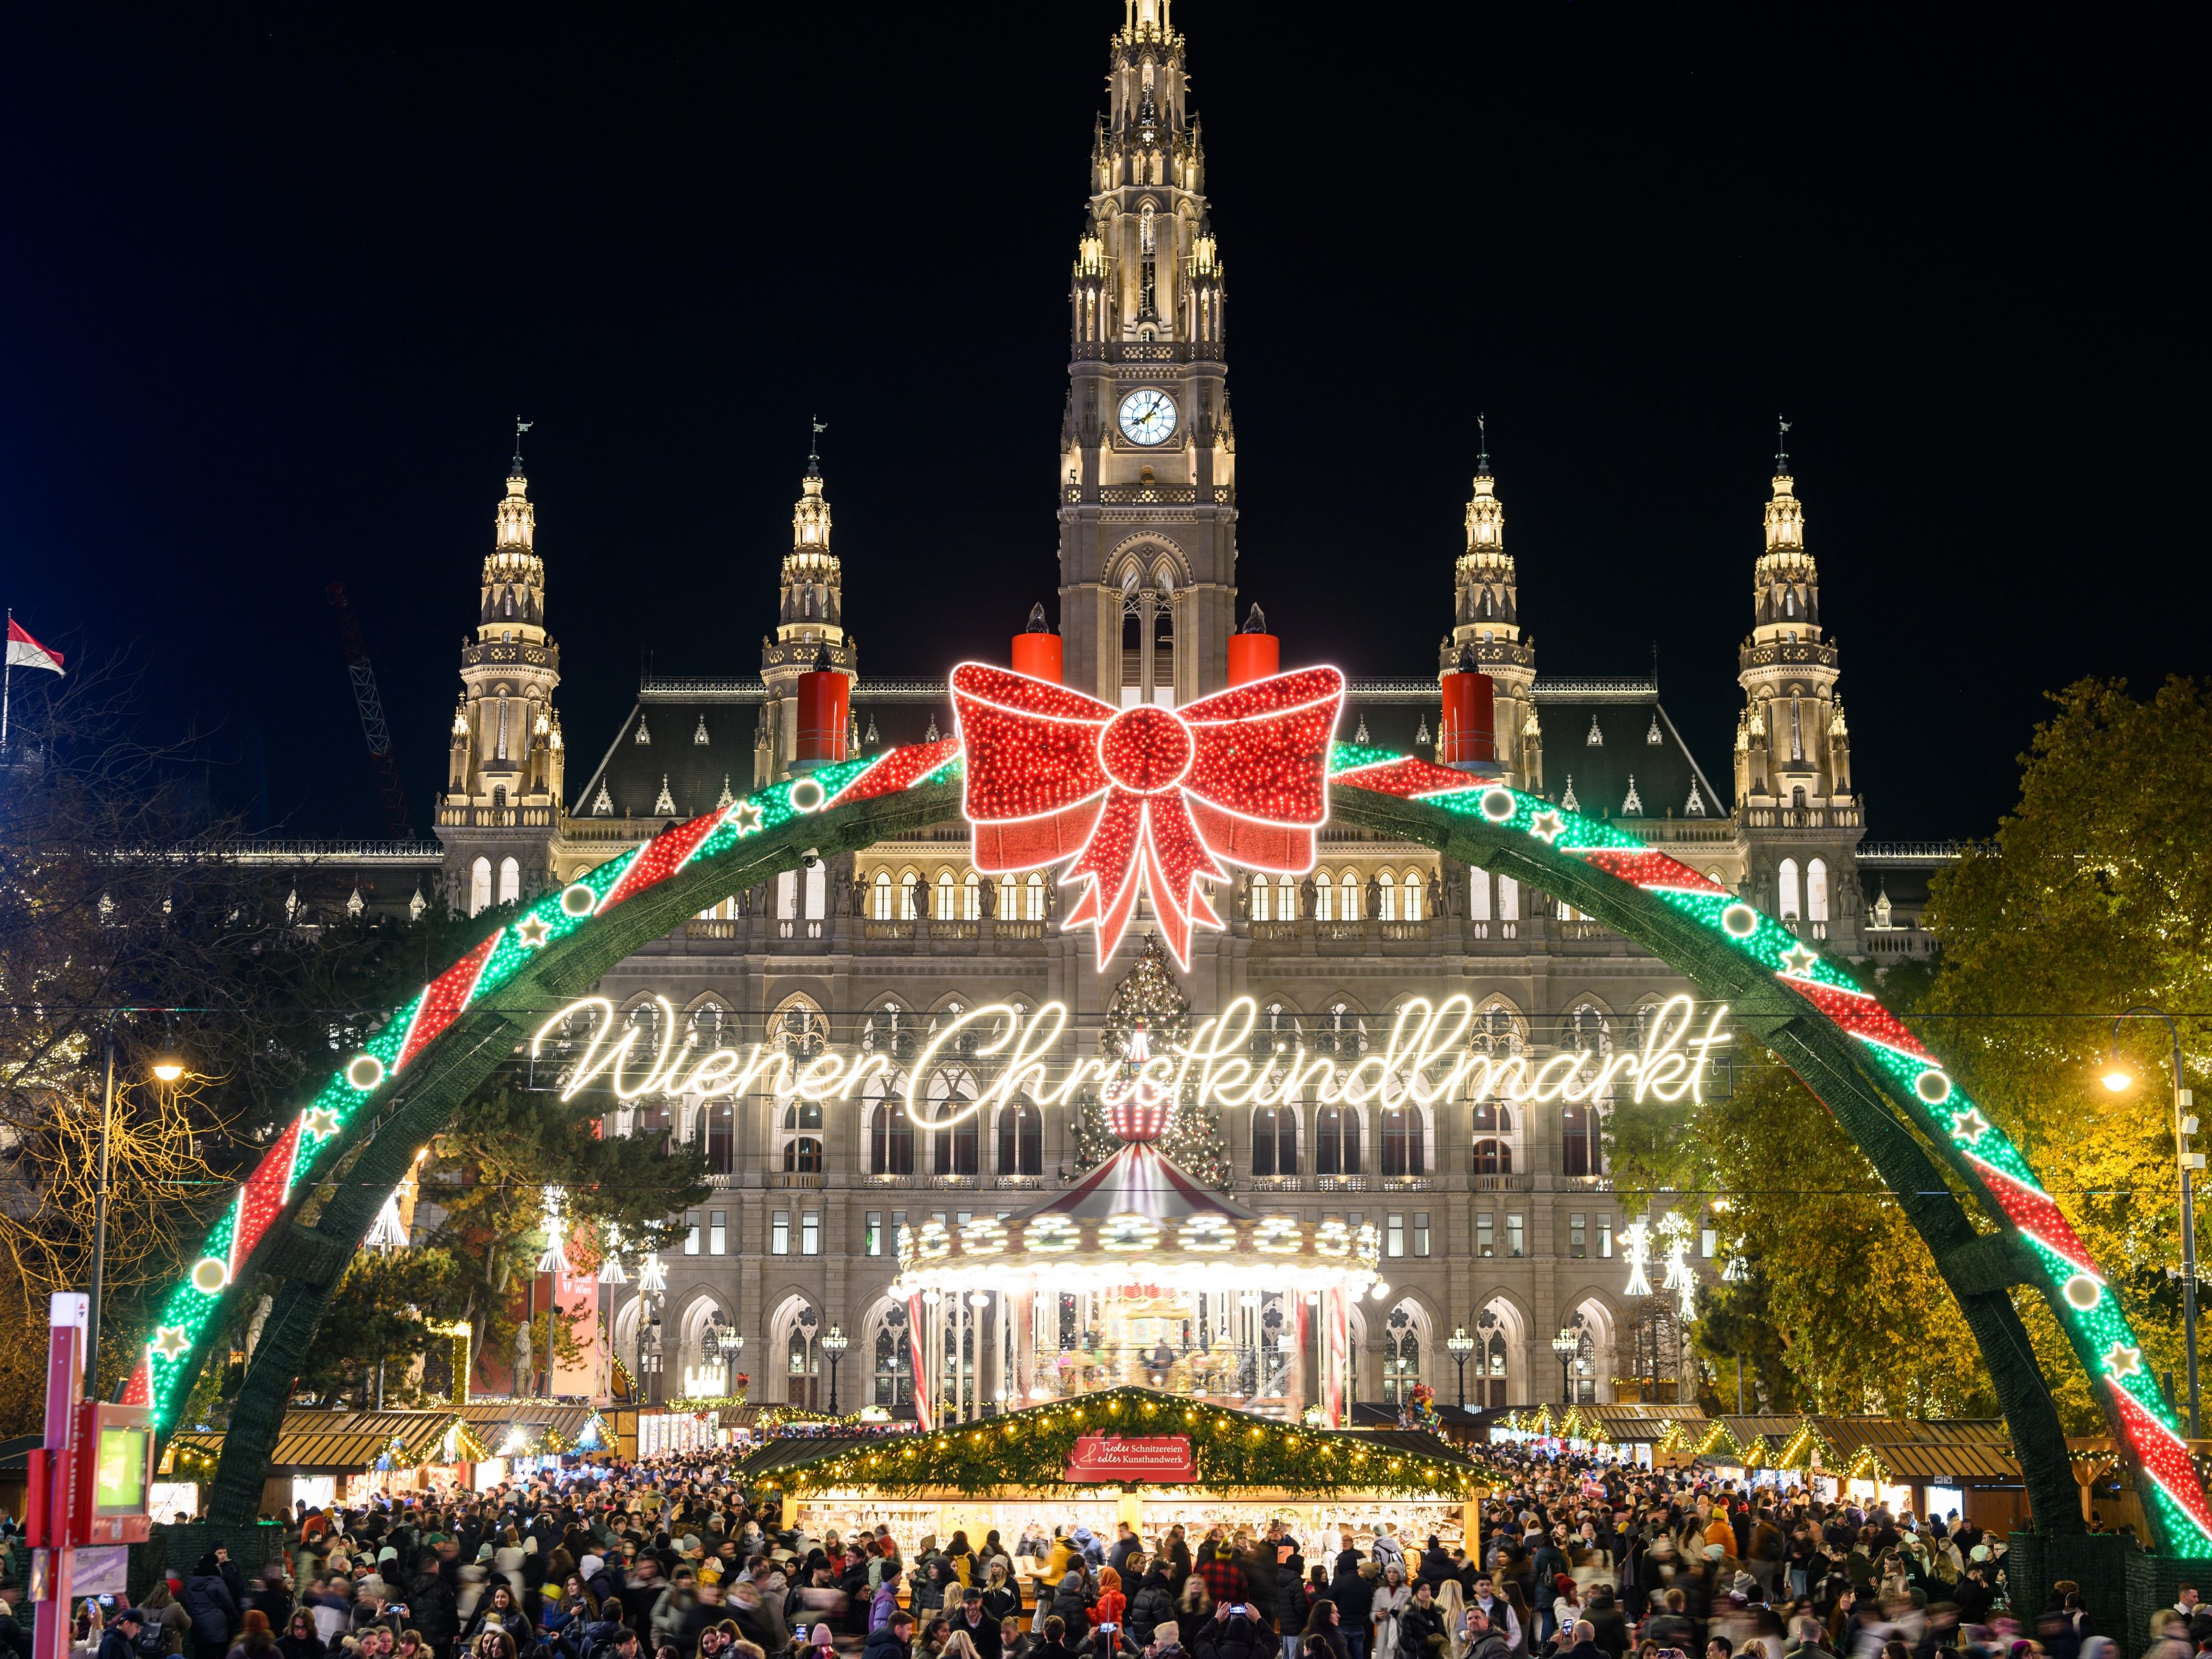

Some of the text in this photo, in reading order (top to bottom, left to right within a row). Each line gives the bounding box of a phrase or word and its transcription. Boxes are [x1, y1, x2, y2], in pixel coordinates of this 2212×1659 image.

[532, 994, 1731, 1129] Wiener Christkindlmarkt
[574, 1284, 592, 1295] Wien
[1100, 1442, 1183, 1453] Tiroler Schnitzereien
[1097, 1452, 1121, 1463] edles
[1122, 1455, 1183, 1463] Kunsthandwerk
